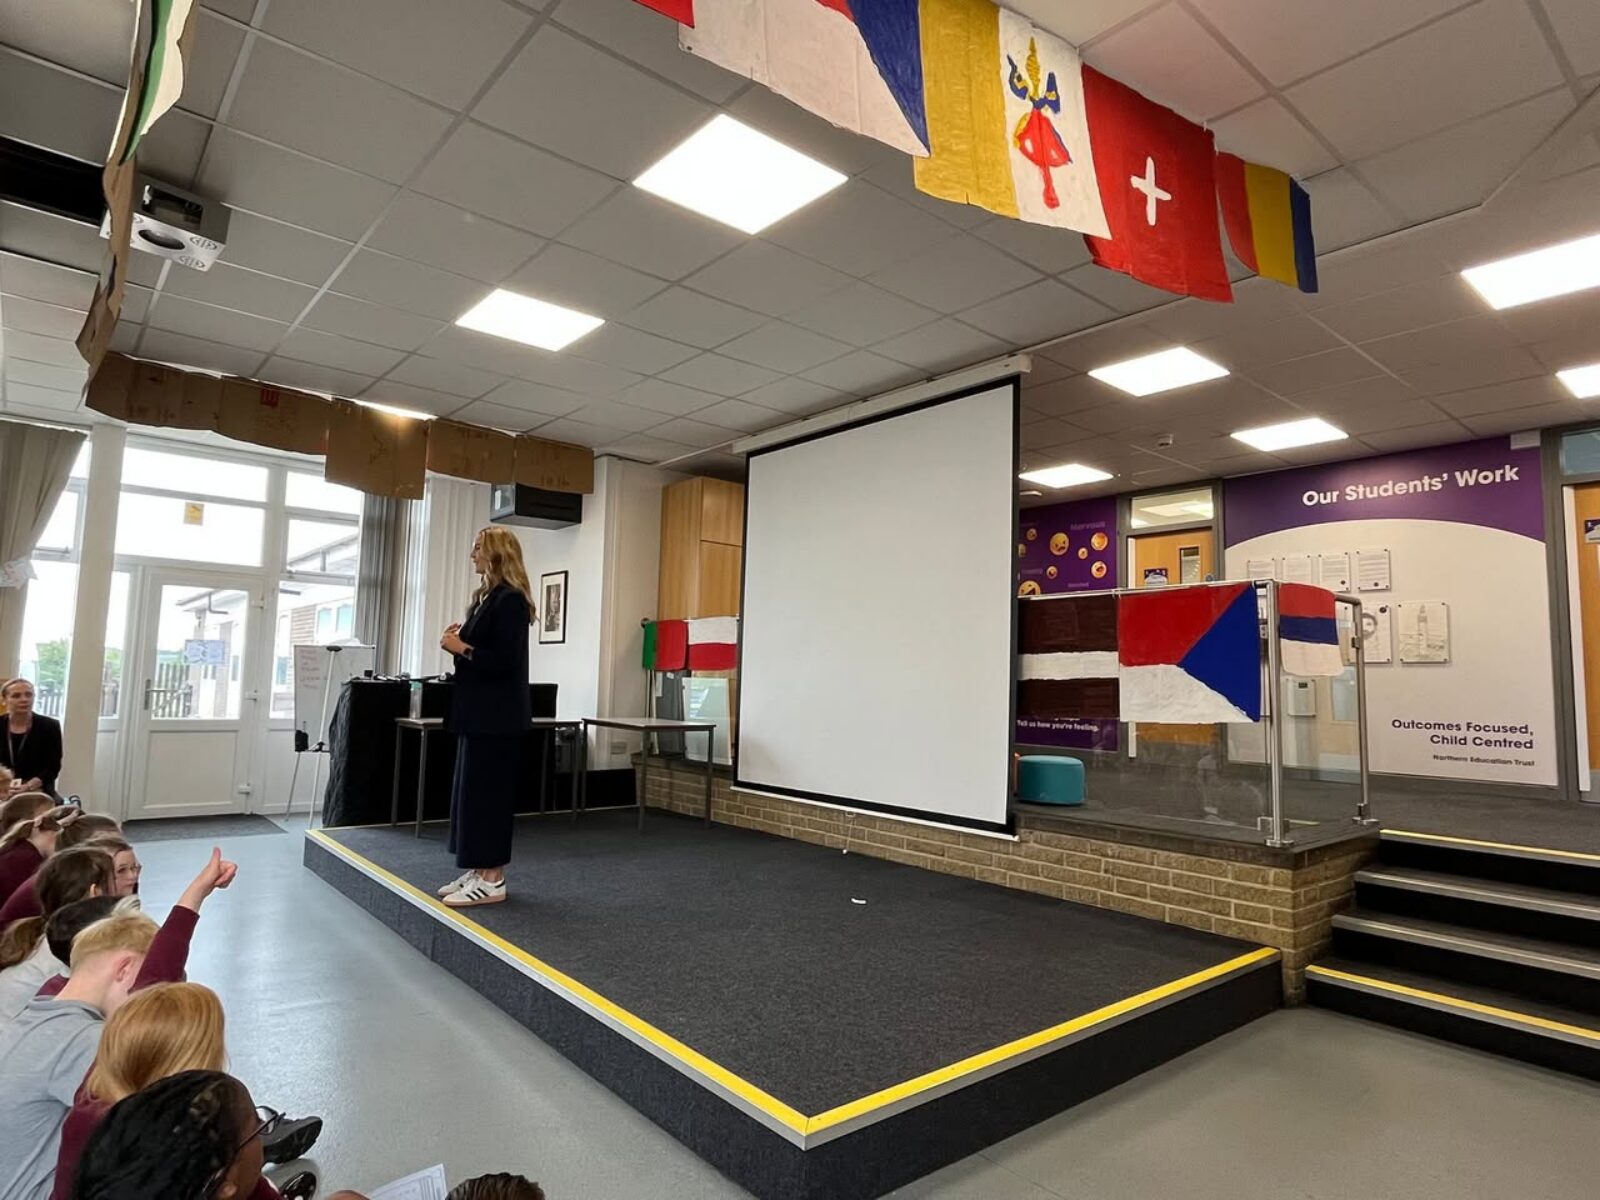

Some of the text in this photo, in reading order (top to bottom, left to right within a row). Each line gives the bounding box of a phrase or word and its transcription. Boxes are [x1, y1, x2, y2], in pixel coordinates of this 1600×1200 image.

[1302, 489, 1340, 506] Our
[1454, 465, 1519, 487] Work
[1391, 719, 1534, 736] Outcomes Focused,
[1430, 734, 1534, 749] Child Centred
[1433, 754, 1535, 767] Northern Education Trust
